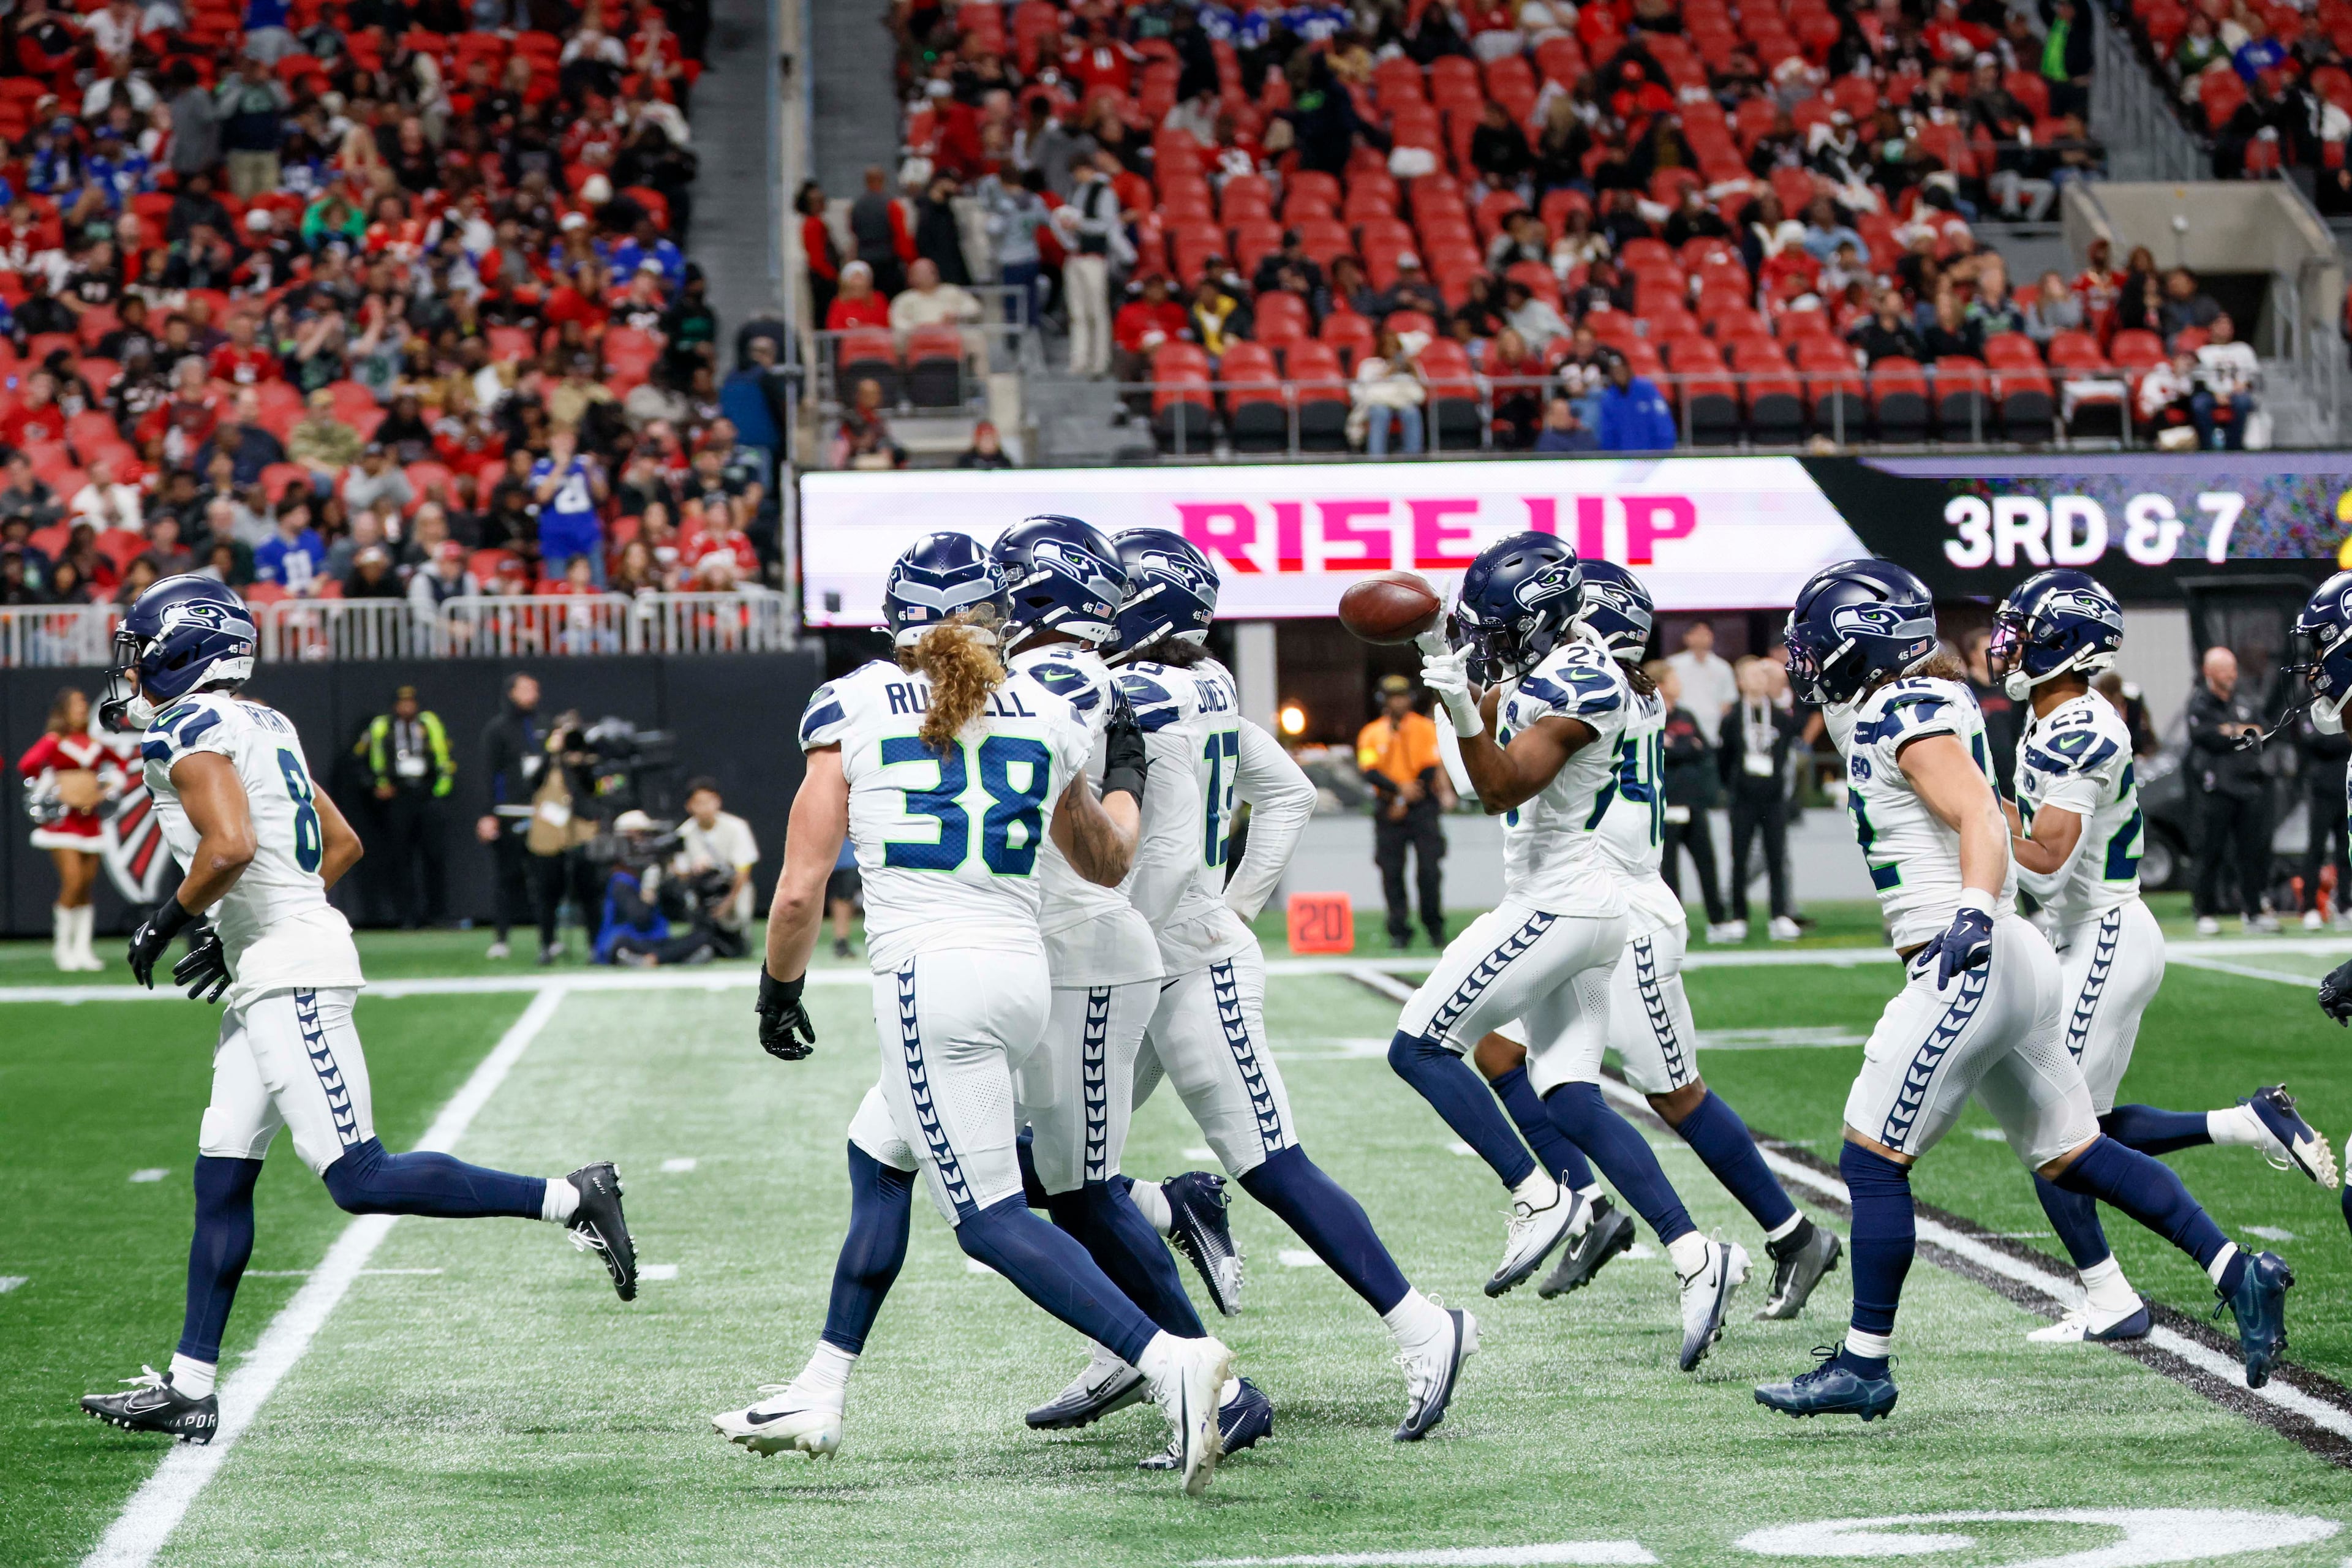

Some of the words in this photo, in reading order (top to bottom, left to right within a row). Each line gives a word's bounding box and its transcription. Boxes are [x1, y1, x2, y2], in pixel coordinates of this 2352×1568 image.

[1172, 499, 1479, 573] RISE
[1520, 496, 1697, 565] UP
[1944, 495, 2109, 568] 3RD
[2125, 492, 2184, 565] &
[2198, 491, 2245, 564] 7
[1082, 601, 1095, 613] 45
[898, 610, 906, 620] 45
[1193, 610, 1202, 620] 45
[1628, 630, 1637, 640] 45
[2104, 635, 2113, 646] 45
[228, 643, 239, 654] 45
[1898, 650, 1909, 661] 45
[885, 682, 1036, 718] RULL
[276, 747, 322, 873] 8
[878, 733, 1053, 878] 38
[1299, 902, 1343, 941] 20
[592, 1176, 606, 1194] VAPOR
